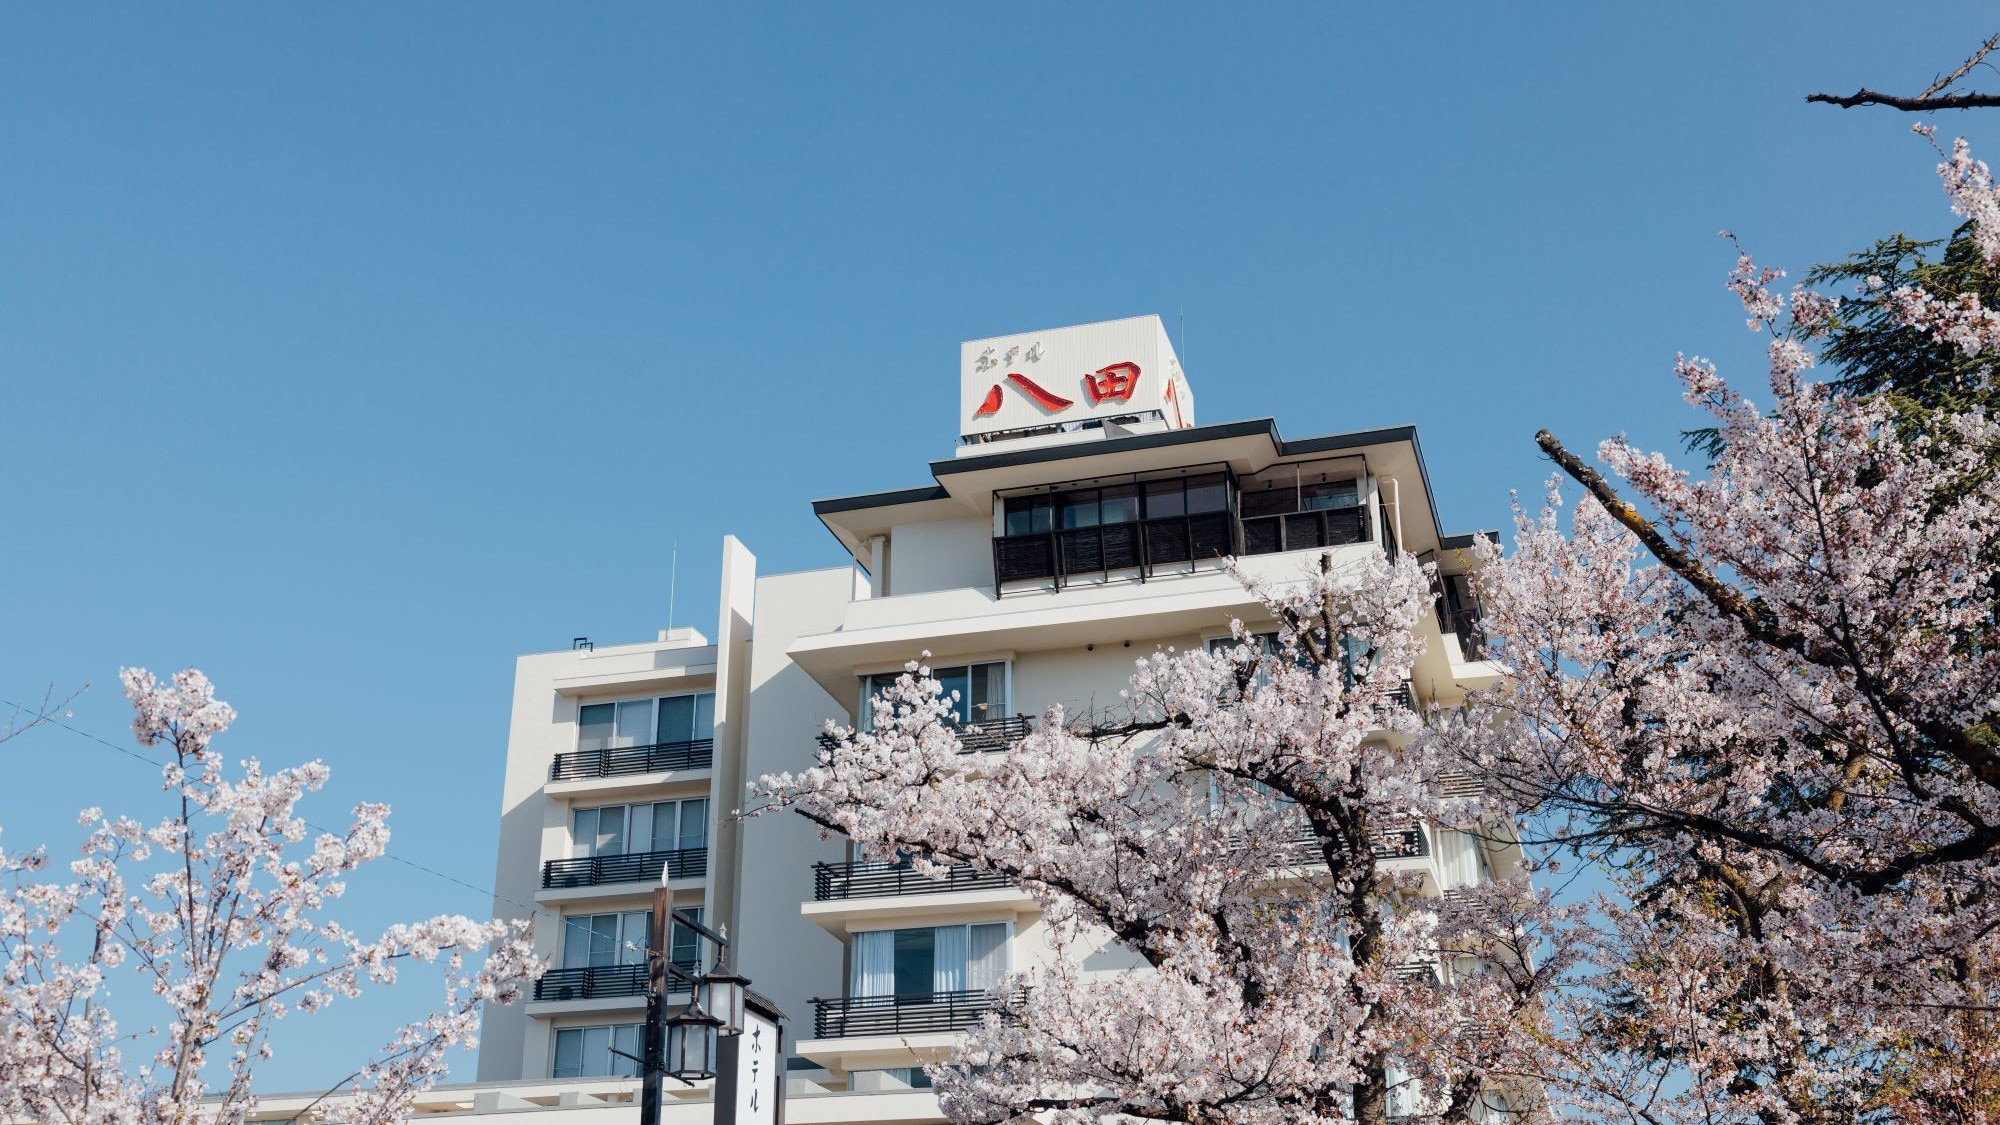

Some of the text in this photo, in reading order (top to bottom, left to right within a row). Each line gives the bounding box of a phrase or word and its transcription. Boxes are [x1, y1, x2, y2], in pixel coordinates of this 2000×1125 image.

[976, 341, 1045, 373] ホテル
[976, 361, 1141, 417] 八田
[750, 1024, 761, 1113] ホテル
